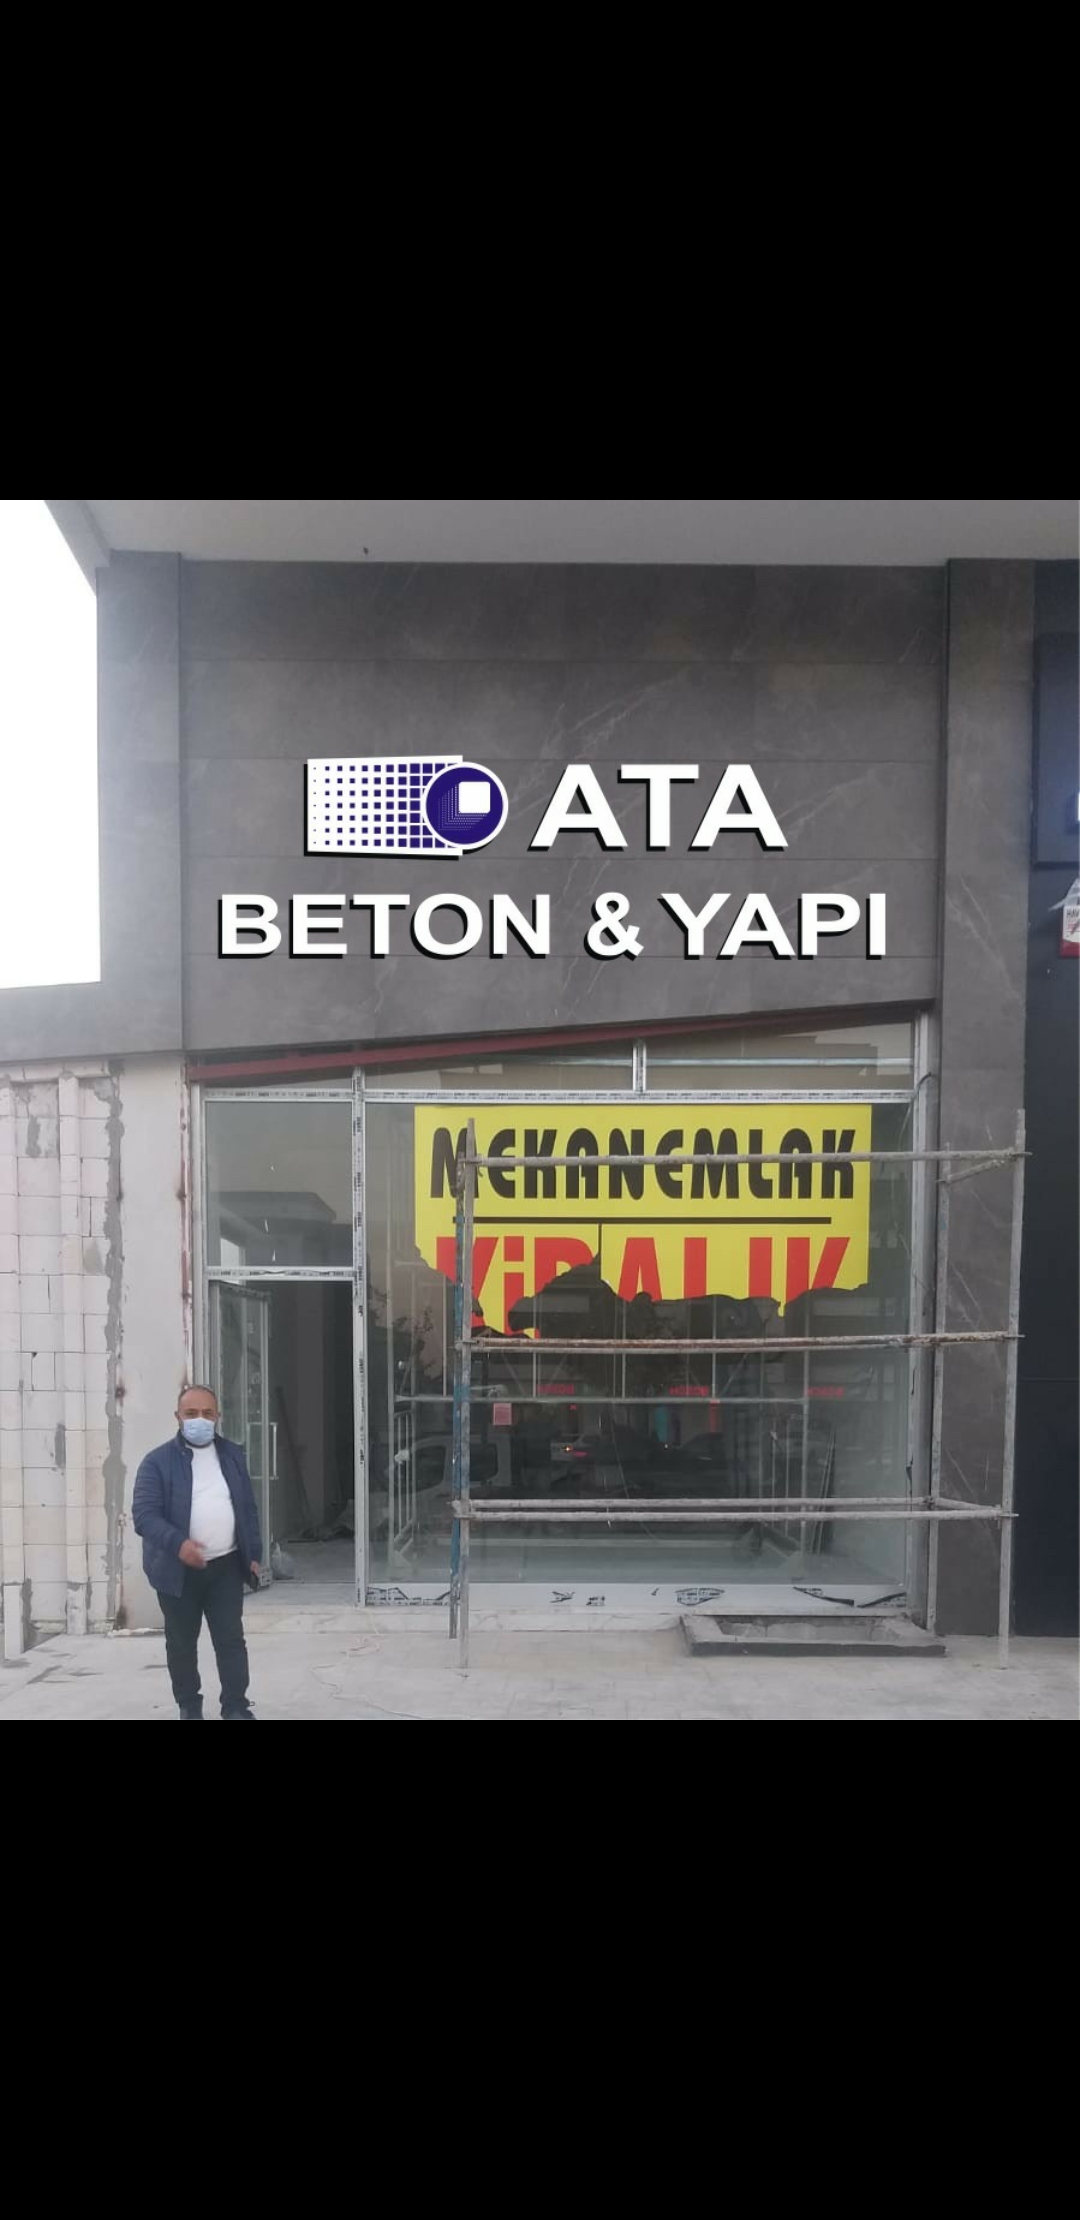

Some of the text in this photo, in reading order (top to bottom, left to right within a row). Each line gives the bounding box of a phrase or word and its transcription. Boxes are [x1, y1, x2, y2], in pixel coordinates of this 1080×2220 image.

[529, 764, 788, 849] ATA
[219, 891, 886, 958] BETON & YAPI
